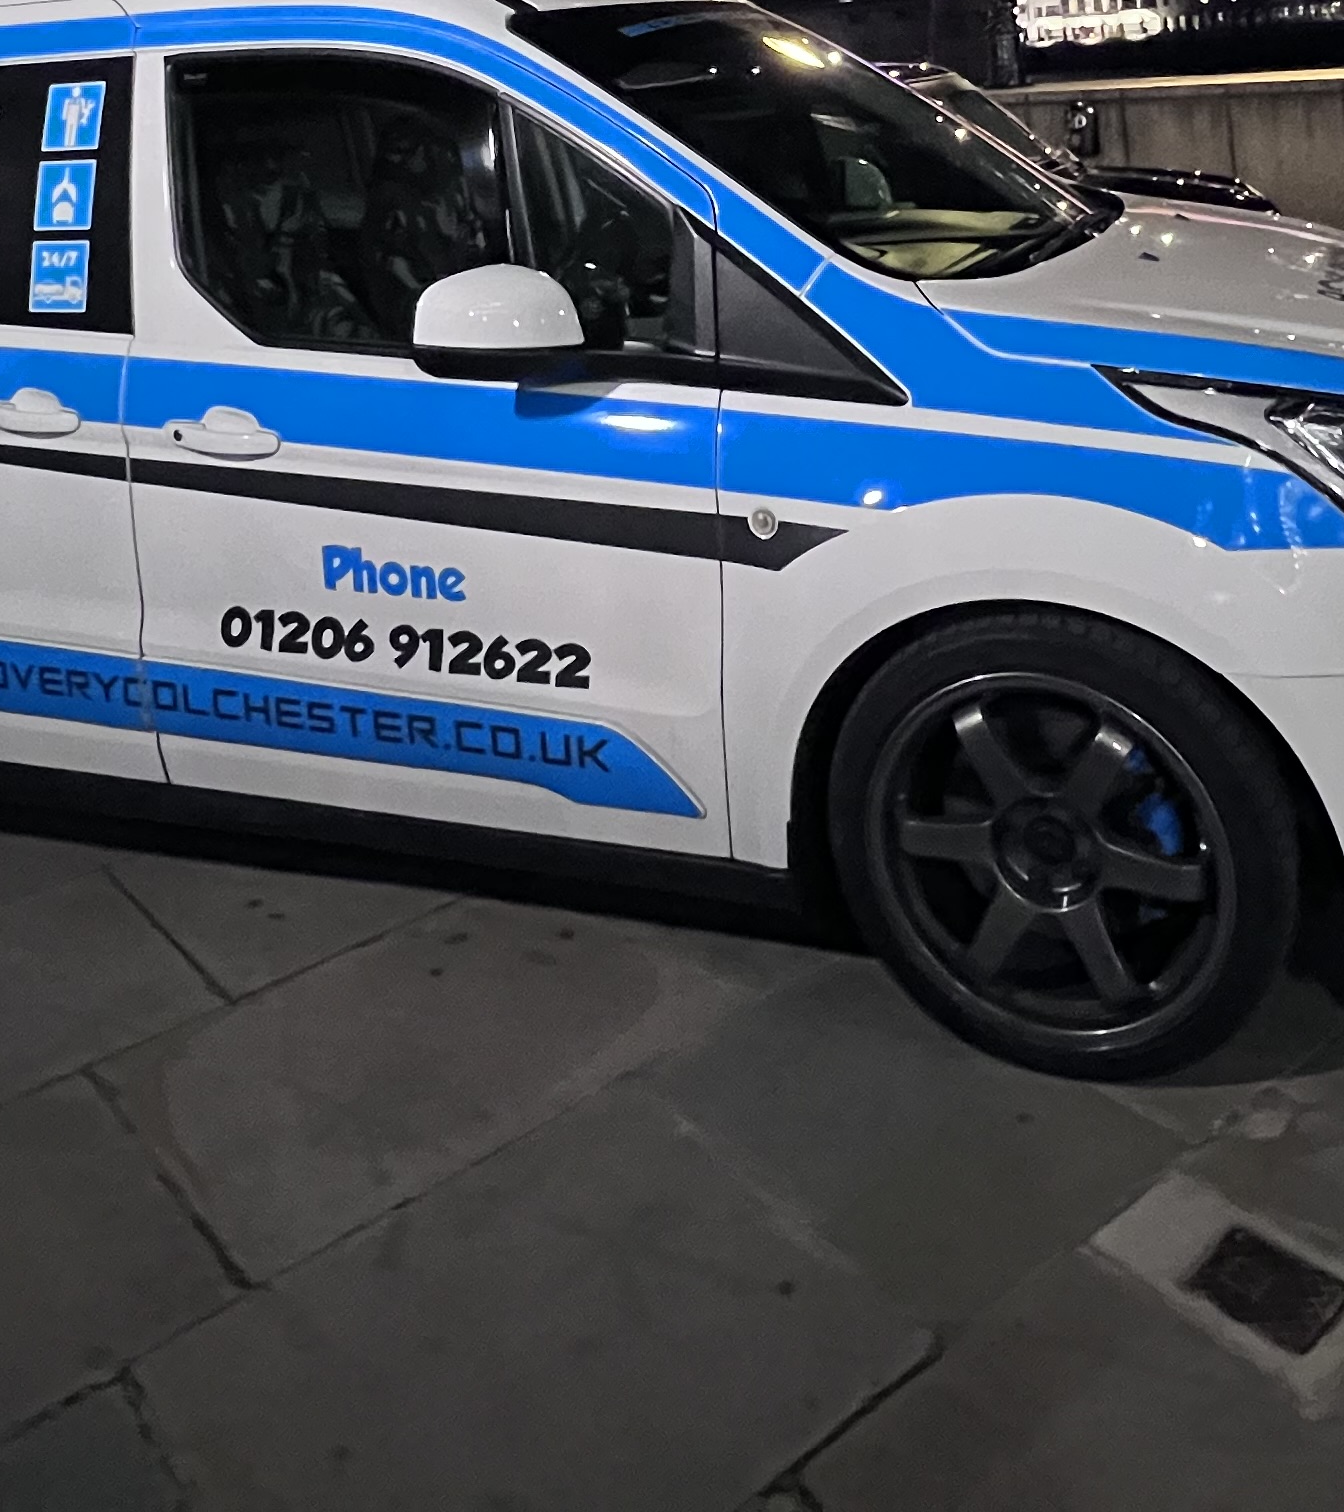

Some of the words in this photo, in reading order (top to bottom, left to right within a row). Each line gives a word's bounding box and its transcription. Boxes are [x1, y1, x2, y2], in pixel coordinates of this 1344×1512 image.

[322, 544, 467, 602] Phone
[221, 605, 375, 663] 01206
[389, 624, 592, 690] 912622
